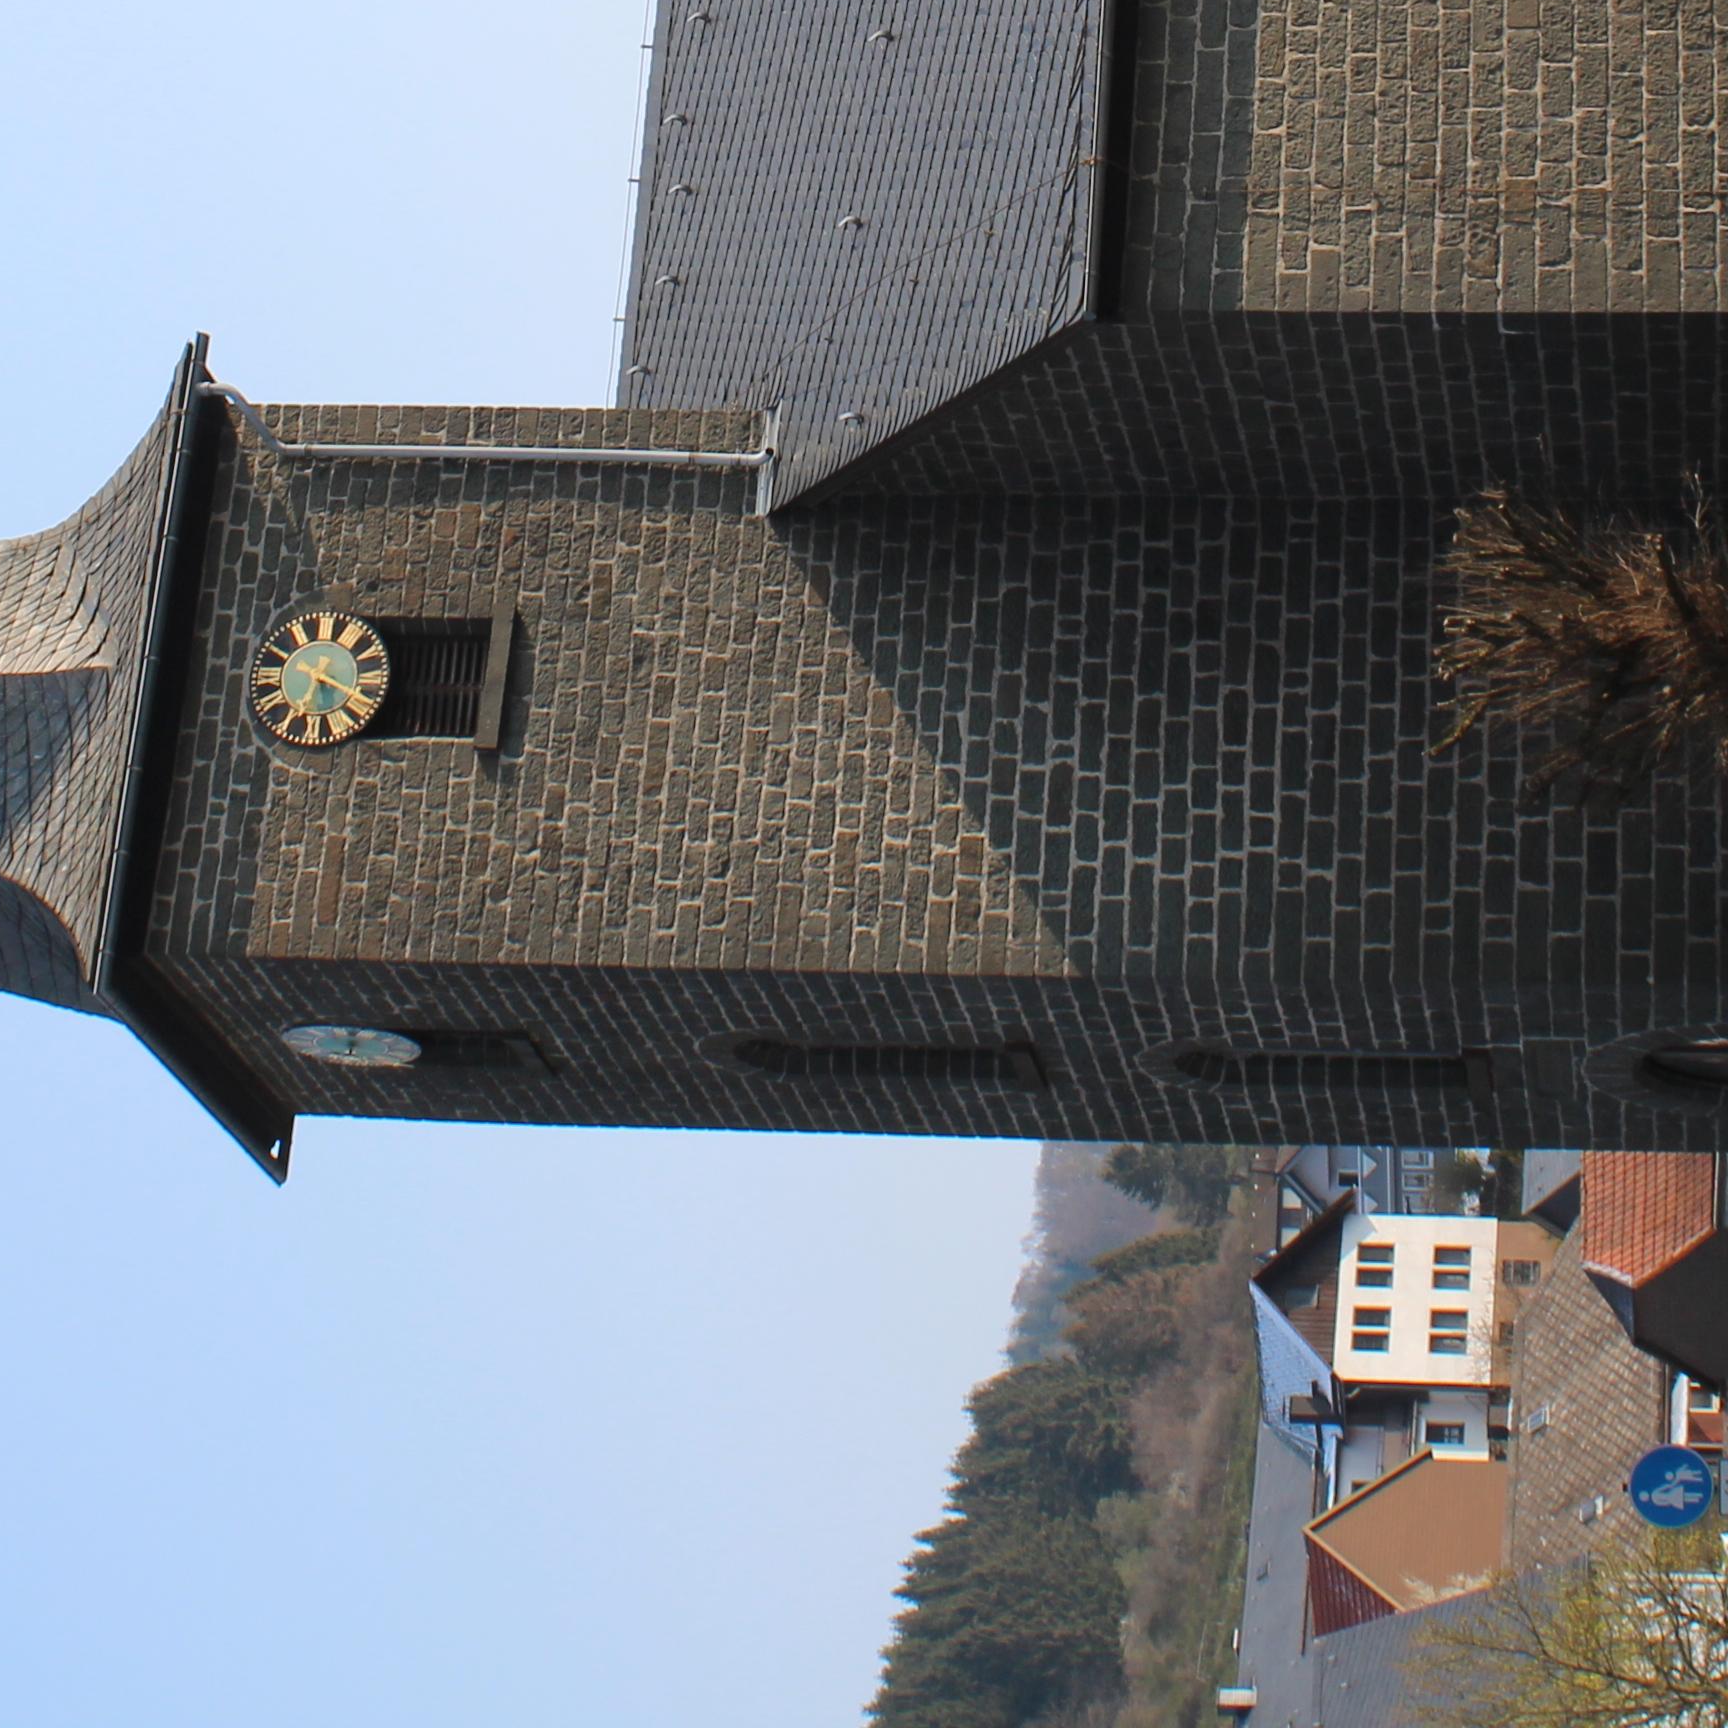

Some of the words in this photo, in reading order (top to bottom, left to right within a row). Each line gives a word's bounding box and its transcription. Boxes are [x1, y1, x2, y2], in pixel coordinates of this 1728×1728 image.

[291, 623, 308, 646] II
[318, 617, 334, 640] III
[269, 644, 289, 659] I
[257, 667, 281, 686] XII
[303, 715, 321, 739] IX
